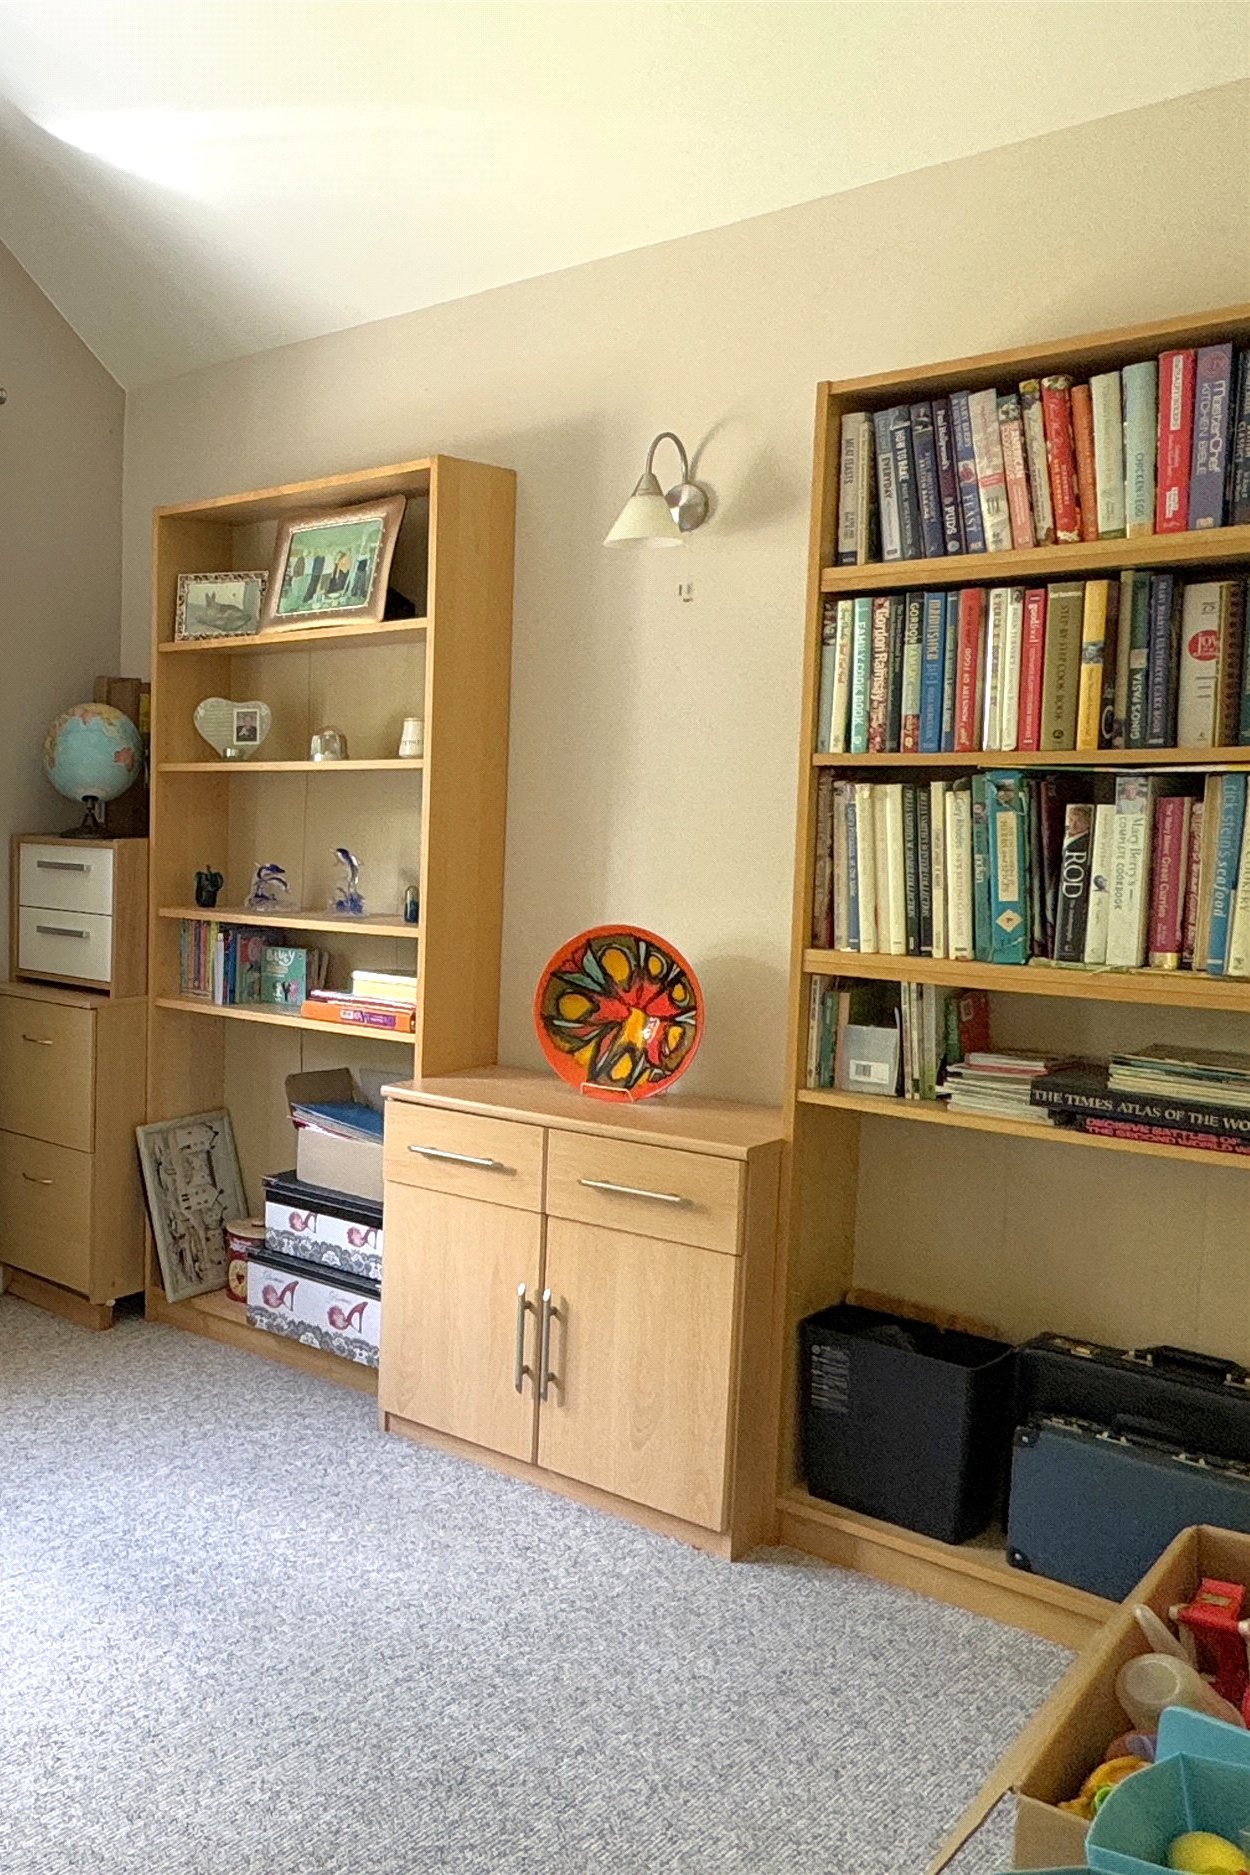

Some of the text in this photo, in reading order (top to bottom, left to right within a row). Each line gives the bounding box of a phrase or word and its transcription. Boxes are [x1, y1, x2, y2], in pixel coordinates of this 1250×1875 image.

[895, 431, 905, 448] HOW
[1208, 380, 1225, 472] MasterChef
[897, 449, 906, 460] TO
[945, 507, 956, 534] PUDS
[963, 494, 977, 532] FEAST
[874, 609, 889, 651] Gordon
[907, 602, 920, 644] GORDON
[854, 622, 866, 724] FAMILY COOK BOOK
[871, 653, 887, 701] Ramsay
[1132, 673, 1143, 702] PASTA
[975, 854, 986, 883] indian
[1114, 816, 1126, 911] COMPLETE COOKBOOK
[1125, 817, 1144, 887] Mary Berry's
[1161, 857, 1172, 882] Great
[1062, 851, 1087, 898] ROD
[1212, 862, 1228, 918] seafood
[1158, 884, 1169, 919] Curries
[1033, 1089, 1063, 1104] THE
[1064, 1094, 1113, 1111] TIMES
[1118, 1103, 1162, 1118] ATLAS
[1165, 1108, 1185, 1121] OF
[1188, 1112, 1219, 1127] THE
[1176, 1136, 1234, 1152] WORLD
